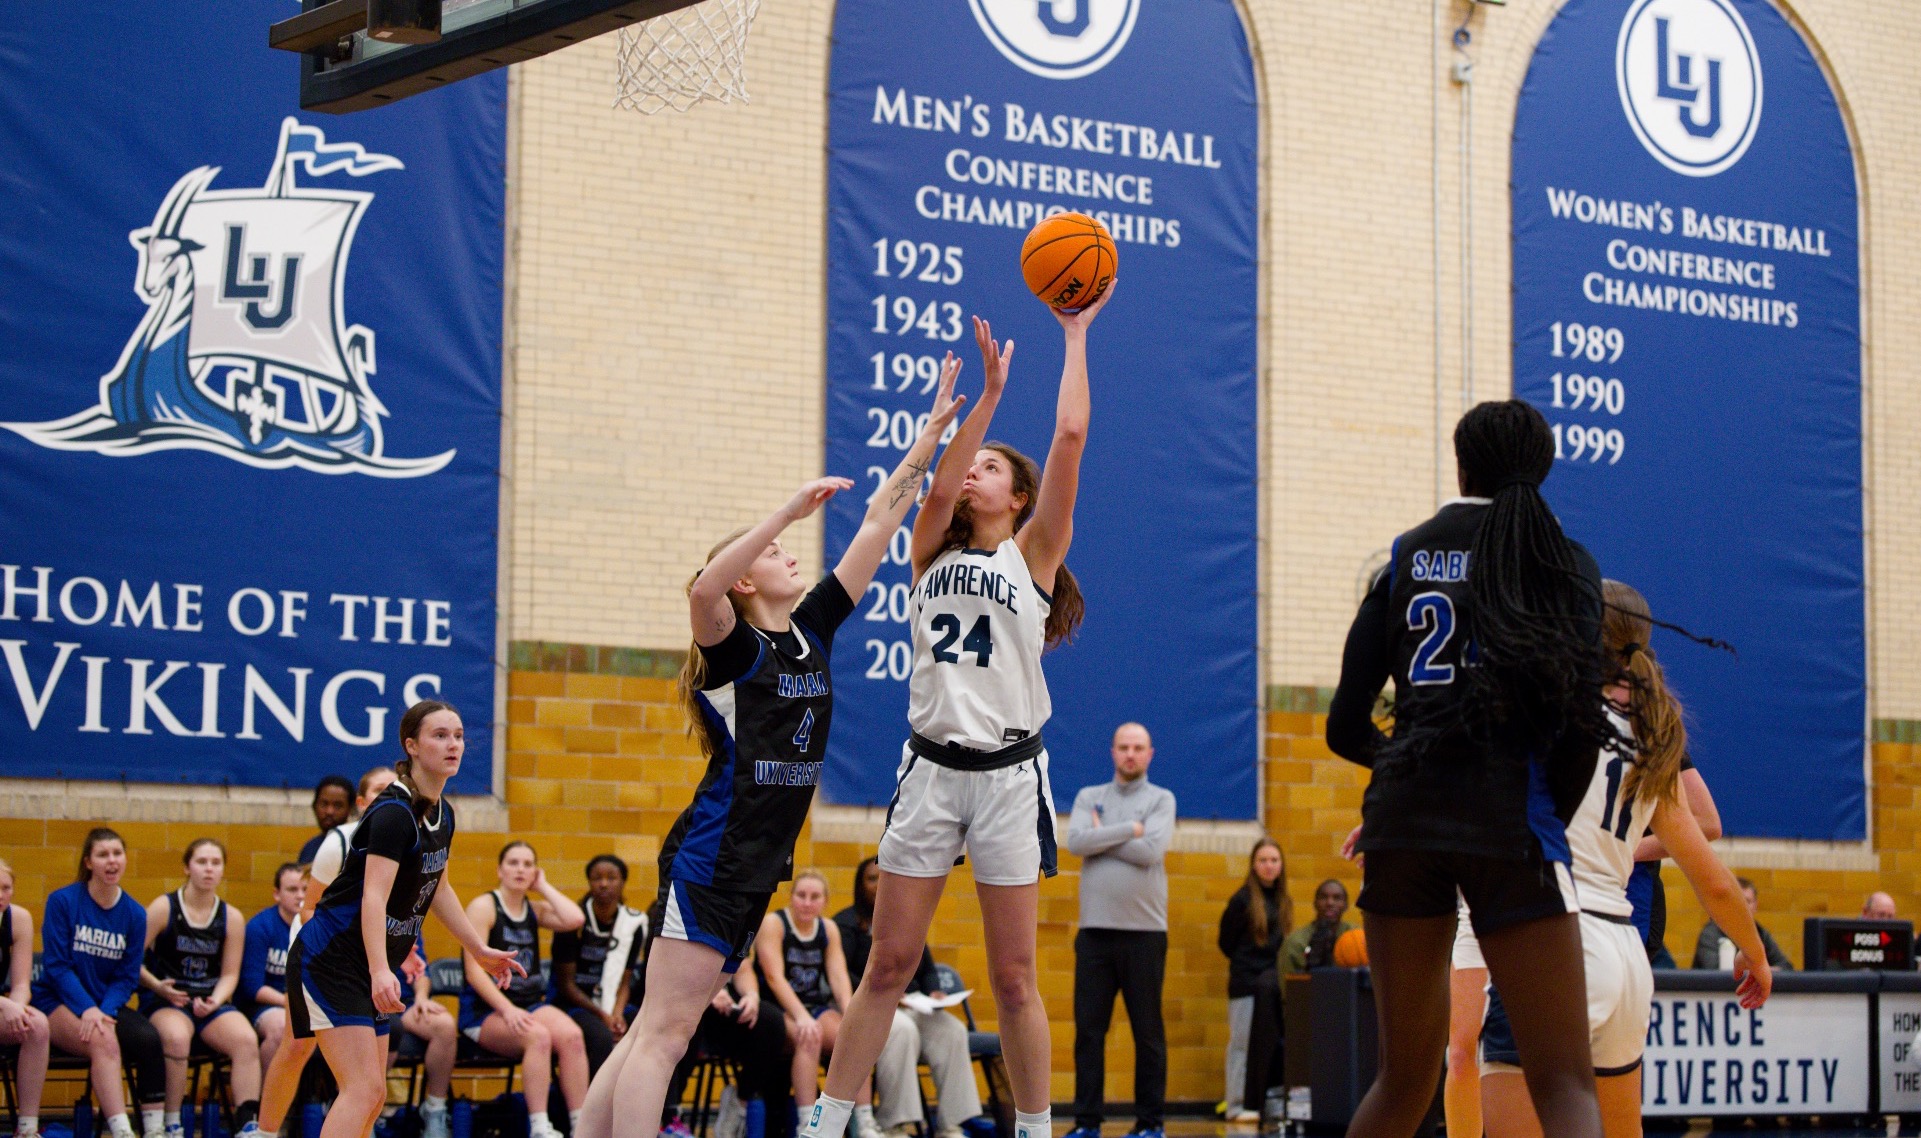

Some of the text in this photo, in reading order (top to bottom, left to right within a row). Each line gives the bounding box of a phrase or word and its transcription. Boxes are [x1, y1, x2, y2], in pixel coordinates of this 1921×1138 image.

[872, 84, 1222, 169] MEN'S BASKETBALL
[944, 148, 1154, 206] CONFERENCE
[915, 185, 1181, 248] CHAMPISHIPS
[1546, 186, 1831, 257] WOMEN'S BASKETBALL
[872, 238, 963, 285] 1925
[1606, 239, 1776, 290] CONFERENCE
[872, 295, 963, 342] 1943
[1582, 272, 1799, 328] CHAMPIONSHIPS
[1549, 321, 1625, 364] 1989
[870, 350, 963, 396] 199
[1549, 373, 1626, 416] 1990
[1553, 424, 1626, 466] 1999
[0, 564, 452, 647] HOME OF THE
[930, 613, 994, 668] 24
[792, 707, 815, 753] 4
[74, 924, 127, 951] MARIAN
[1646, 1001, 1766, 1047] RENCE
[1893, 1011, 1921, 1033] HOM
[1641, 1058, 1839, 1106] IVERSITY
[1894, 1073, 1920, 1093] THE
